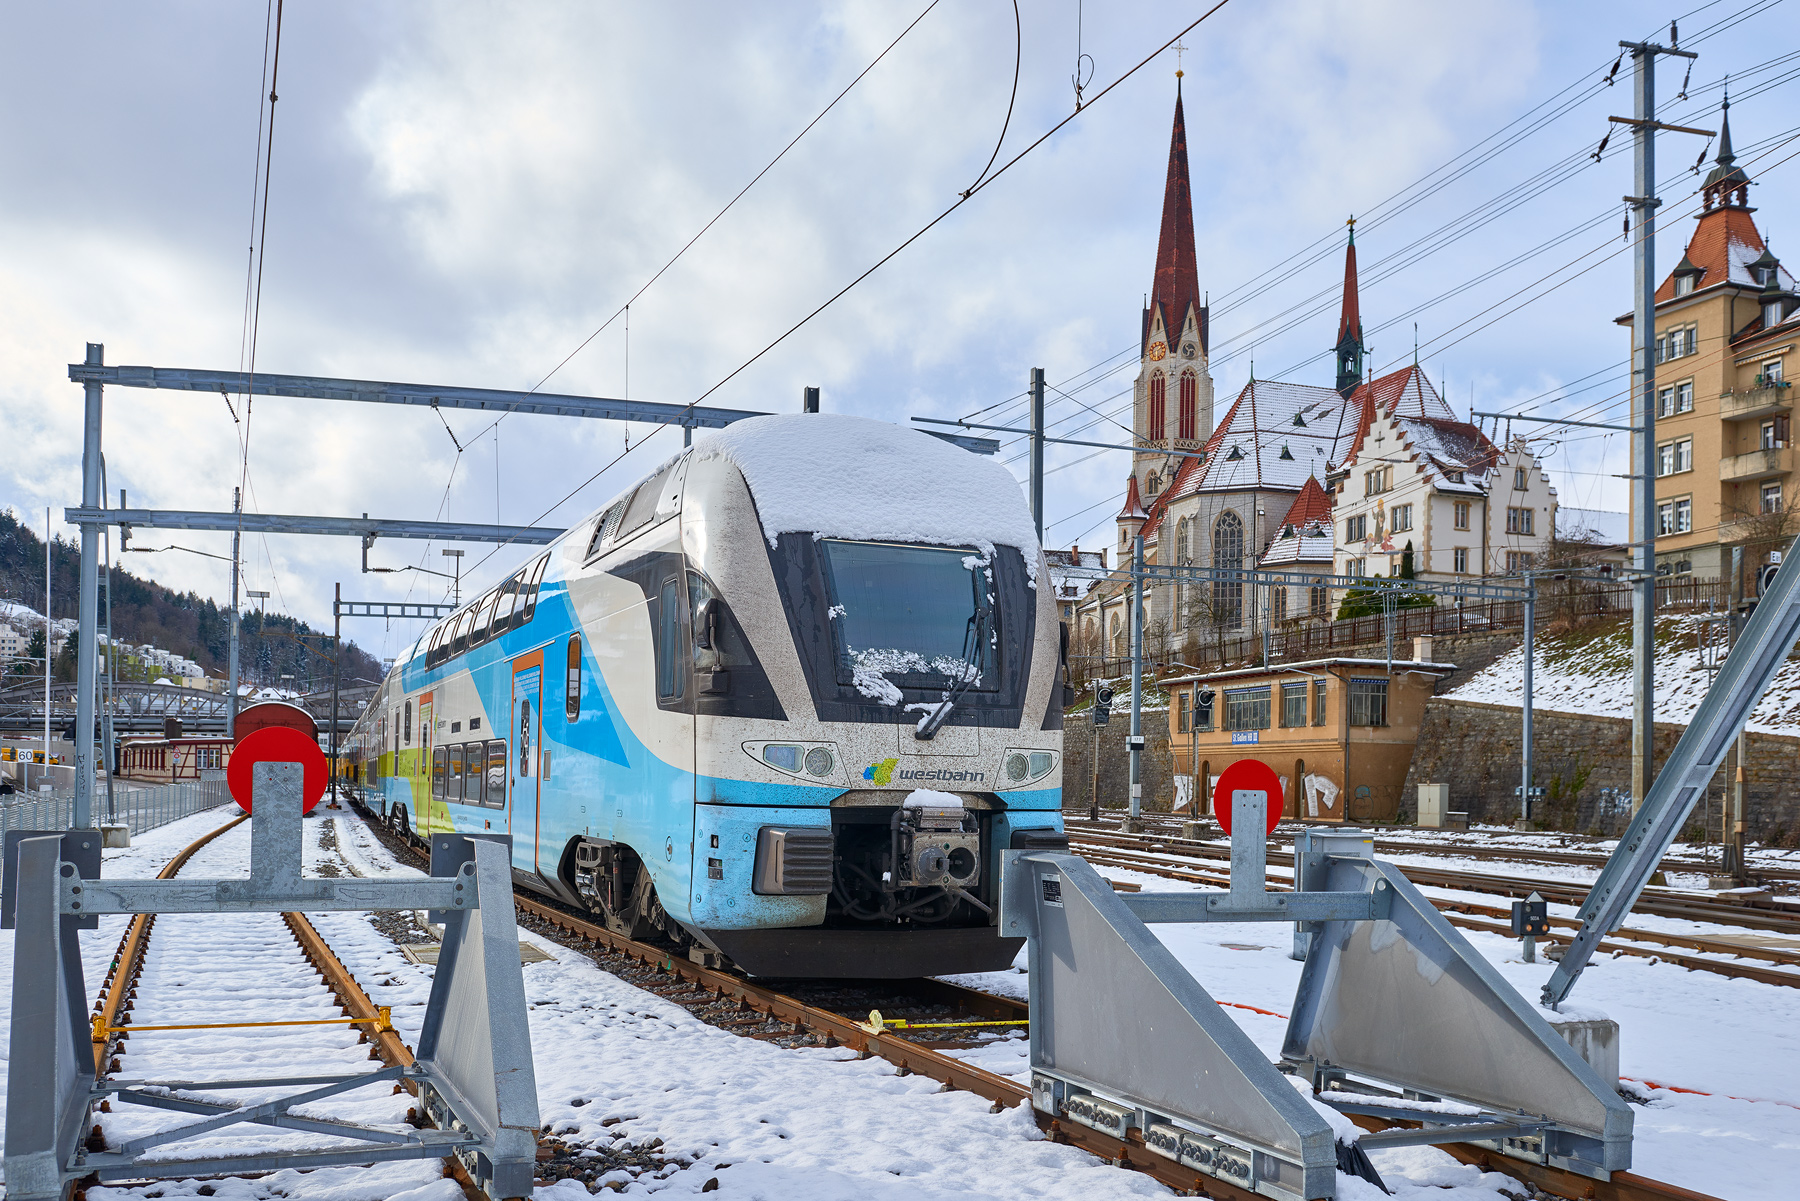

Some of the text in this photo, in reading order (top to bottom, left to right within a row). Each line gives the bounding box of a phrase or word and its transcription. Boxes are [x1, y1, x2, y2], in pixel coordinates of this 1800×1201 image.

[1237, 733, 1247, 741] Gallen
[18, 750, 32, 760] 60
[900, 769, 984, 782] westbahn
